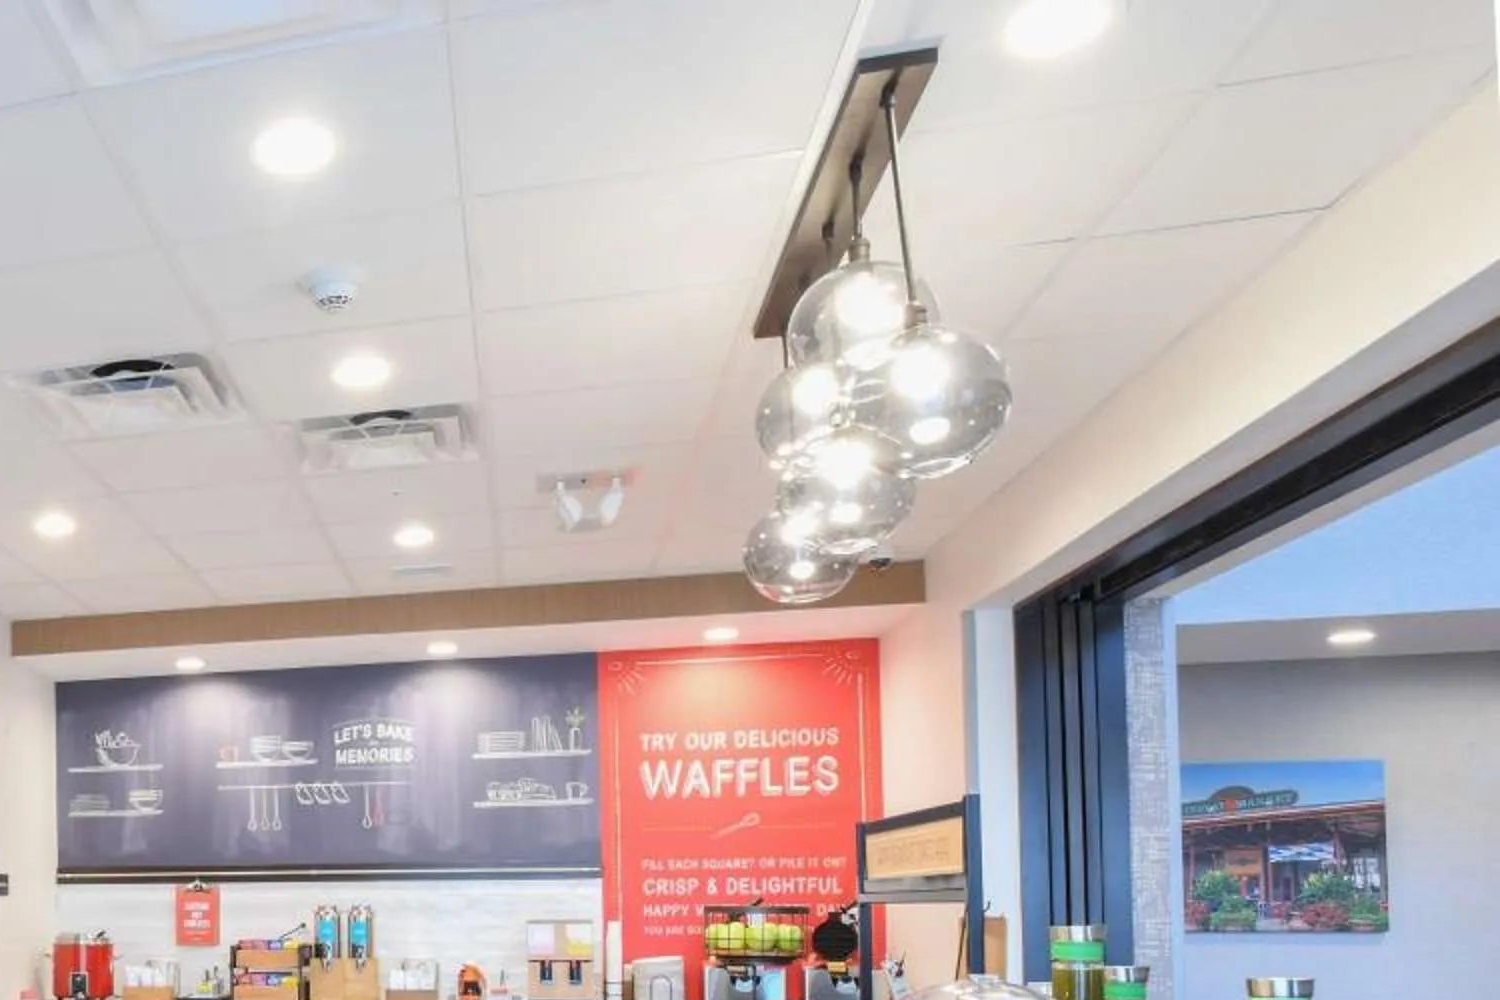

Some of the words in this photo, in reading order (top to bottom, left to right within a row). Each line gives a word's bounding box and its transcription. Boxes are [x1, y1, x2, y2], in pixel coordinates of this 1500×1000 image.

[334, 723, 372, 744] LET'S
[377, 723, 414, 742] BAKE
[640, 732, 677, 751] TRY
[685, 730, 727, 750] OUR
[734, 727, 839, 748] DELICIOUS
[335, 747, 415, 765] MEMORIES
[639, 755, 840, 800] WAFFLES
[641, 858, 664, 871] FILL
[667, 858, 698, 870] EACH
[759, 857, 774, 869] OR
[779, 856, 801, 869] PILE
[807, 856, 818, 868] IT
[642, 877, 699, 896] CRISP
[707, 877, 718, 895] &
[726, 876, 843, 895] DELIGHTFUL
[643, 903, 689, 917] HAPPY
